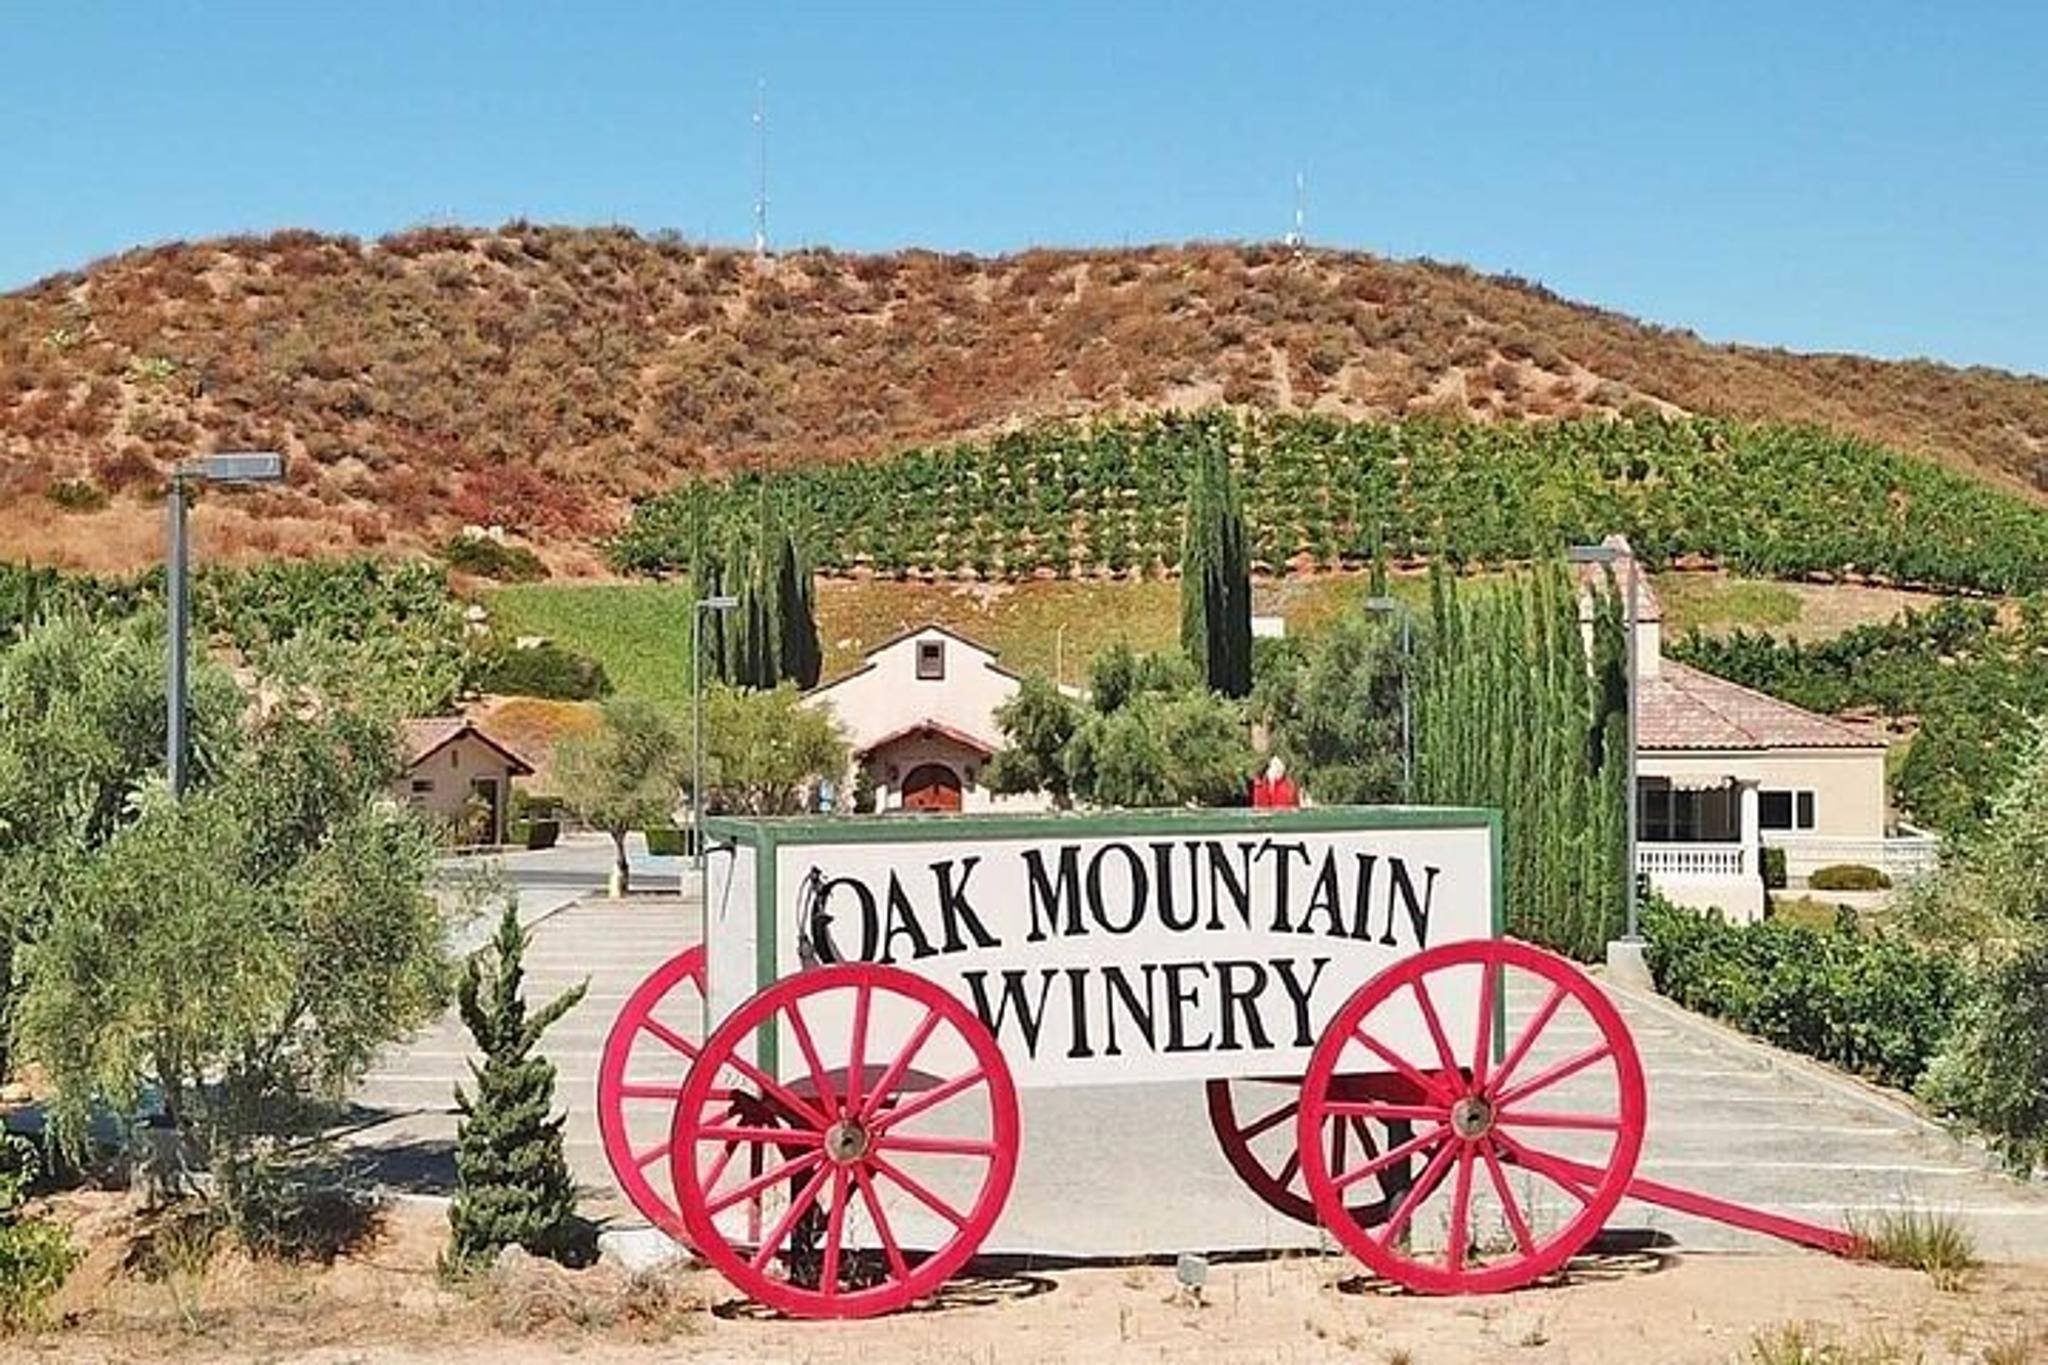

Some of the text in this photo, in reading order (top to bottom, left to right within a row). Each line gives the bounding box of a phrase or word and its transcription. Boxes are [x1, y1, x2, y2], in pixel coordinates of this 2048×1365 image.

[810, 838, 1440, 964] OAK MOUNTAIN
[961, 957, 1331, 1060] WINERY
